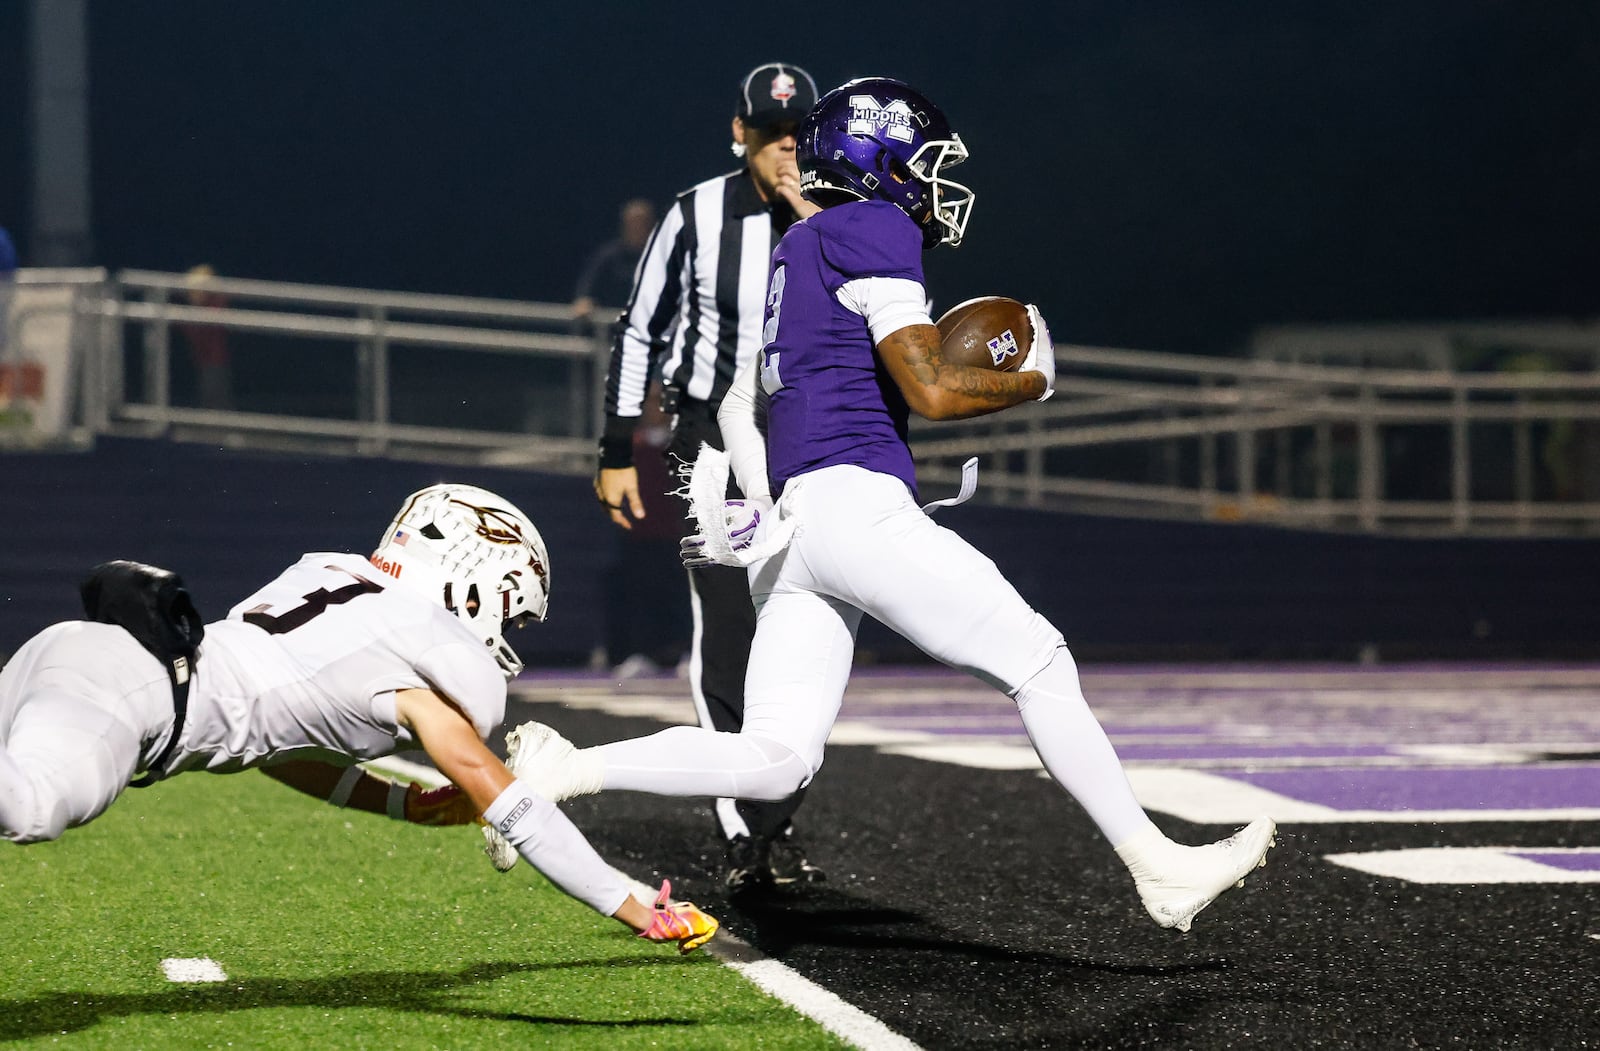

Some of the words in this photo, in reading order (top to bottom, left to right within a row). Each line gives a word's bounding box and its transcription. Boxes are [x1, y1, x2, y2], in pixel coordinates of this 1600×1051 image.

[853, 109, 911, 126] MIDDIES
[370, 554, 402, 579] ddell
[243, 564, 385, 635] 3
[503, 800, 530, 829] BATTLE
